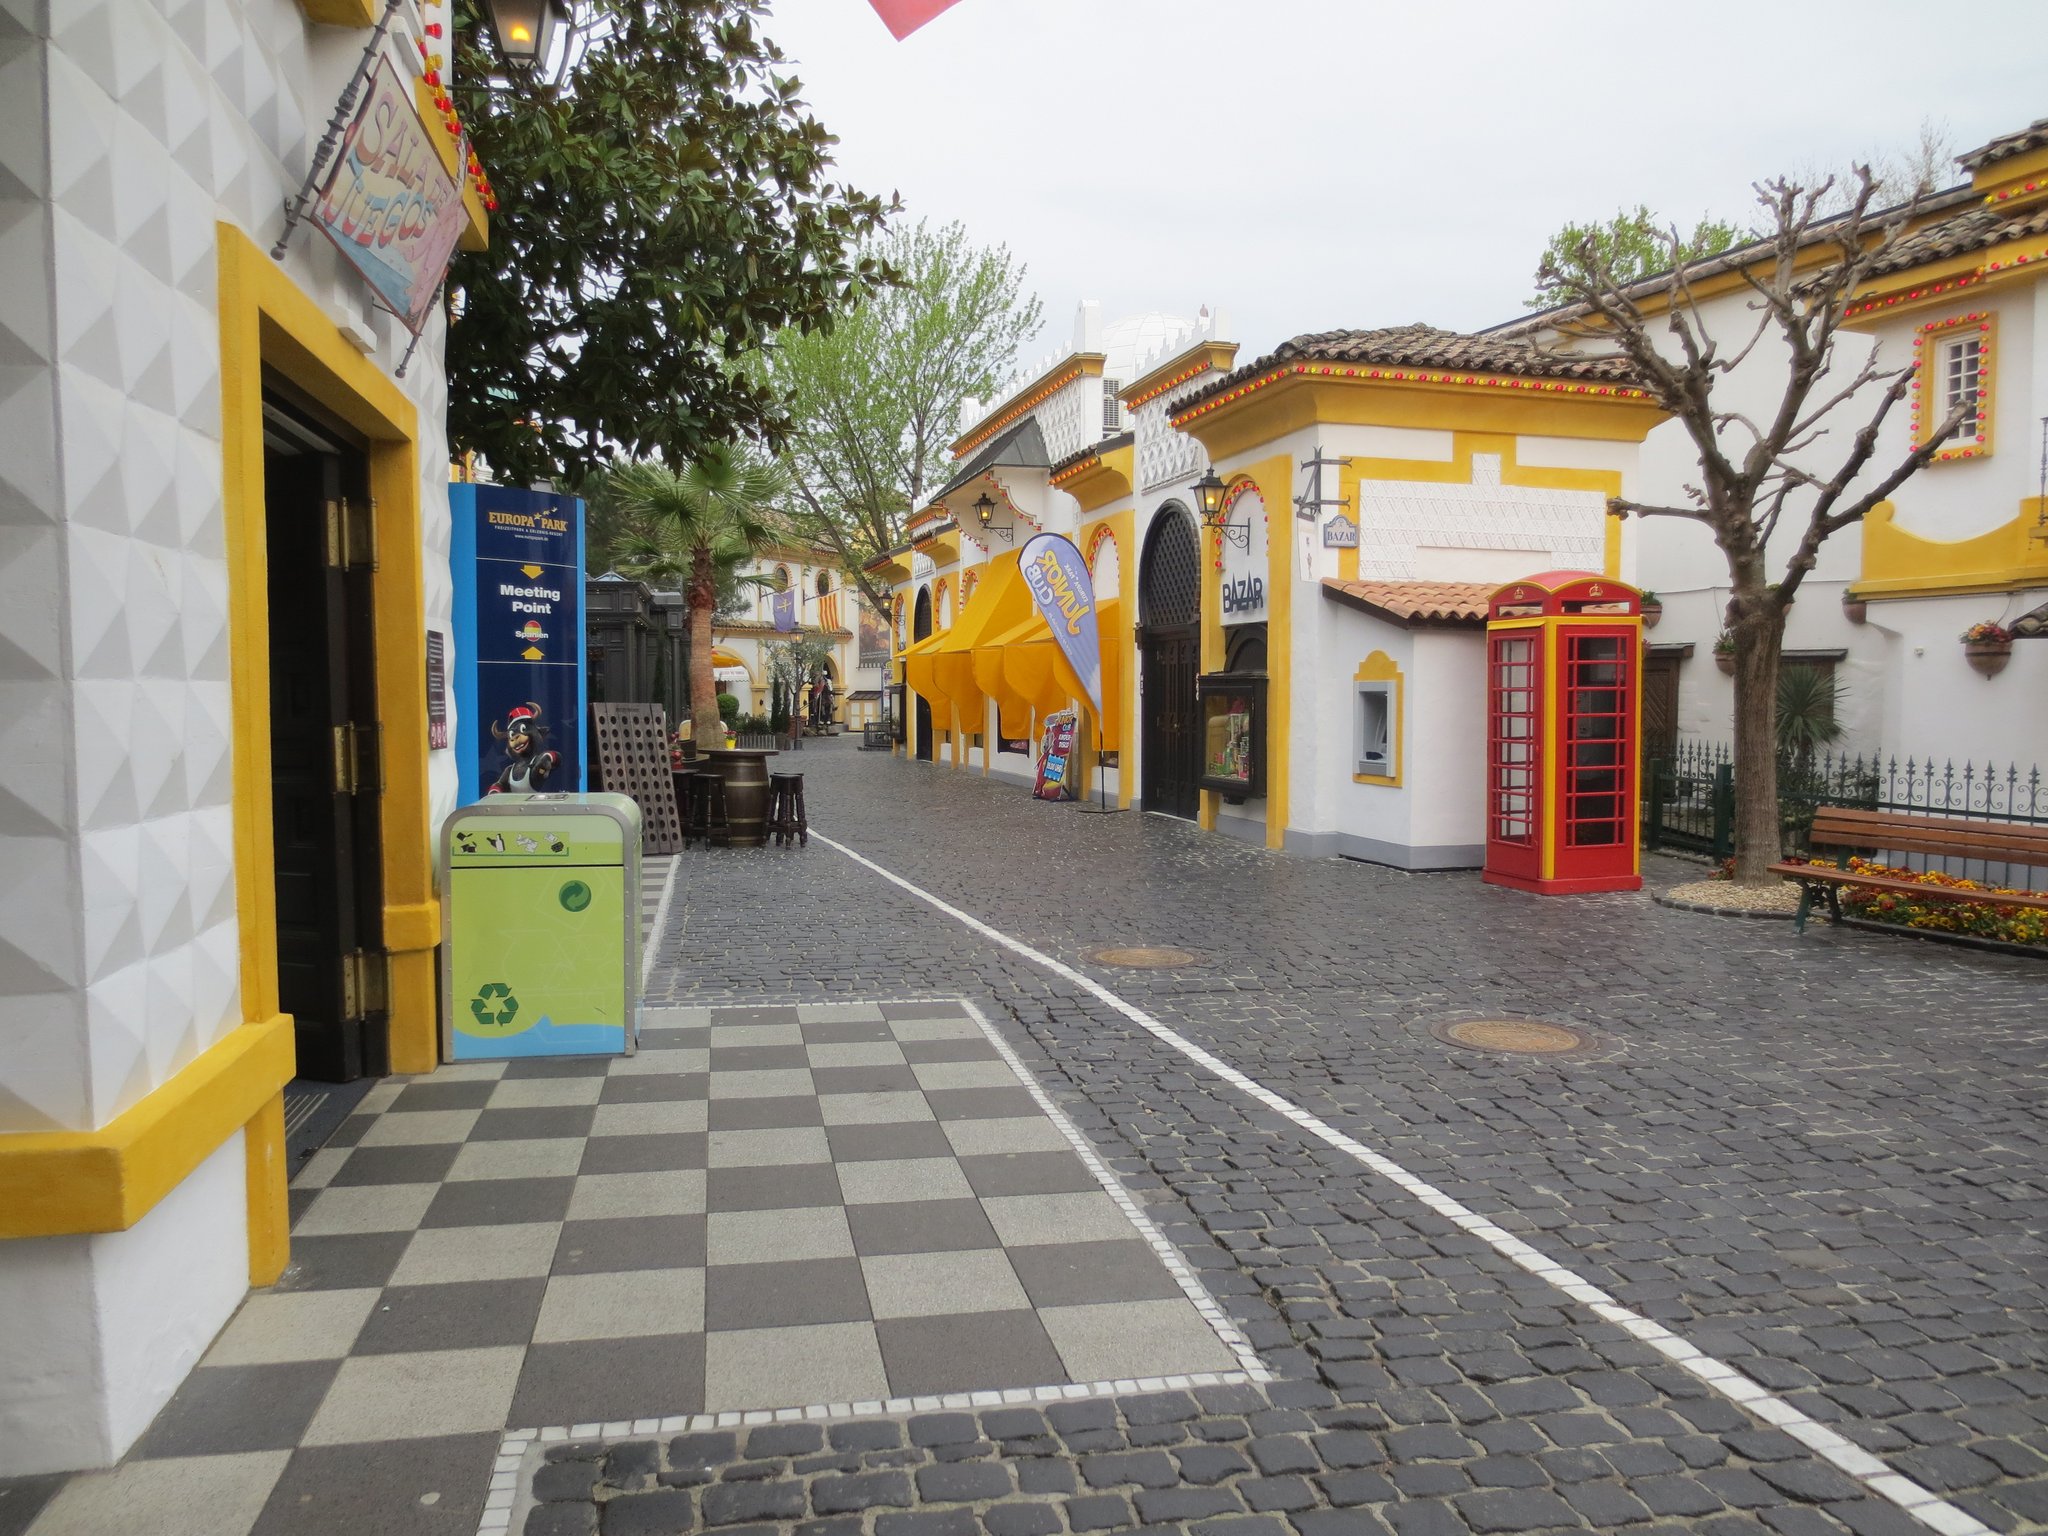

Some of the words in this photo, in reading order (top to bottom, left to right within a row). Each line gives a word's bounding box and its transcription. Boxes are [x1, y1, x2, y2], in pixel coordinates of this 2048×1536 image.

[355, 91, 432, 195] SALA
[321, 146, 438, 249] JUEGOS
[488, 511, 535, 528] EUROPA
[541, 517, 568, 532] PARK
[1327, 531, 1356, 542] BAZAR
[500, 584, 561, 602] Meeting
[1222, 570, 1264, 614] BAZAR
[512, 601, 552, 615] Point
[515, 630, 549, 640] Spanien
